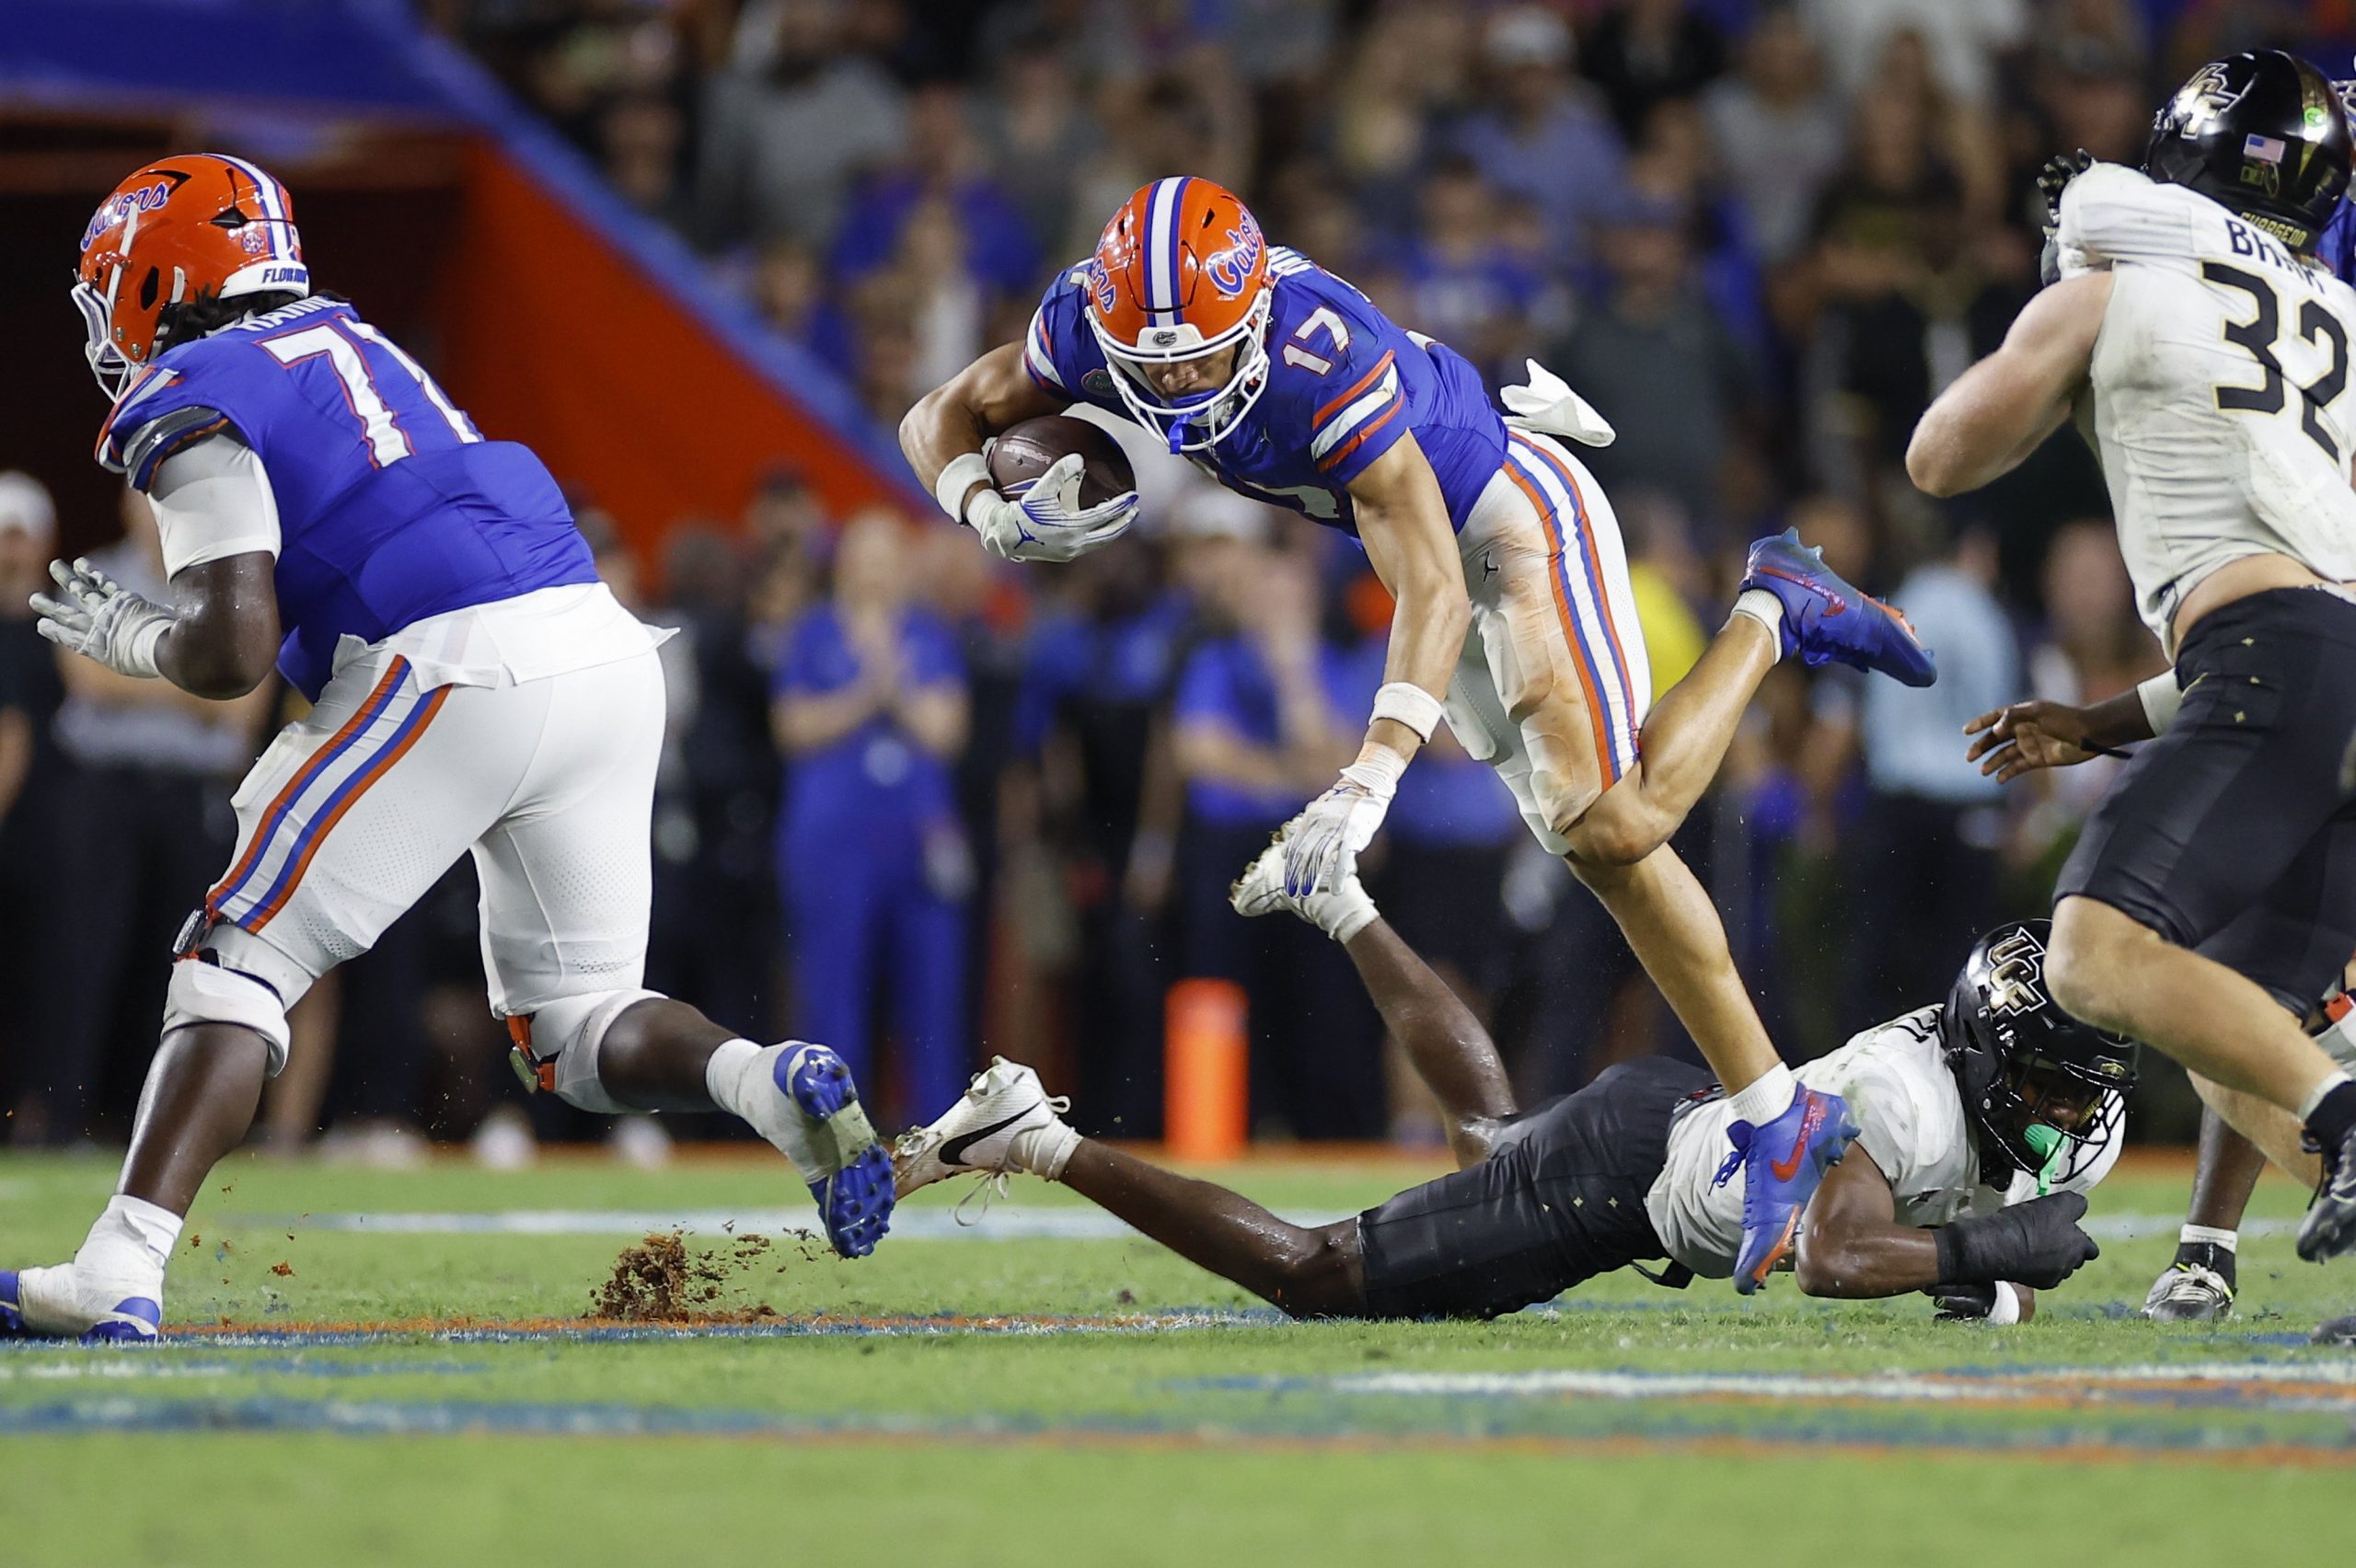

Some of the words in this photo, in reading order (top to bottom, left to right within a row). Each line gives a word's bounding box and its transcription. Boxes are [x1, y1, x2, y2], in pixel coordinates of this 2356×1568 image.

[1281, 305, 1354, 378] 17
[2201, 259, 2349, 466] 32
[1987, 926, 2047, 1017] UCF
